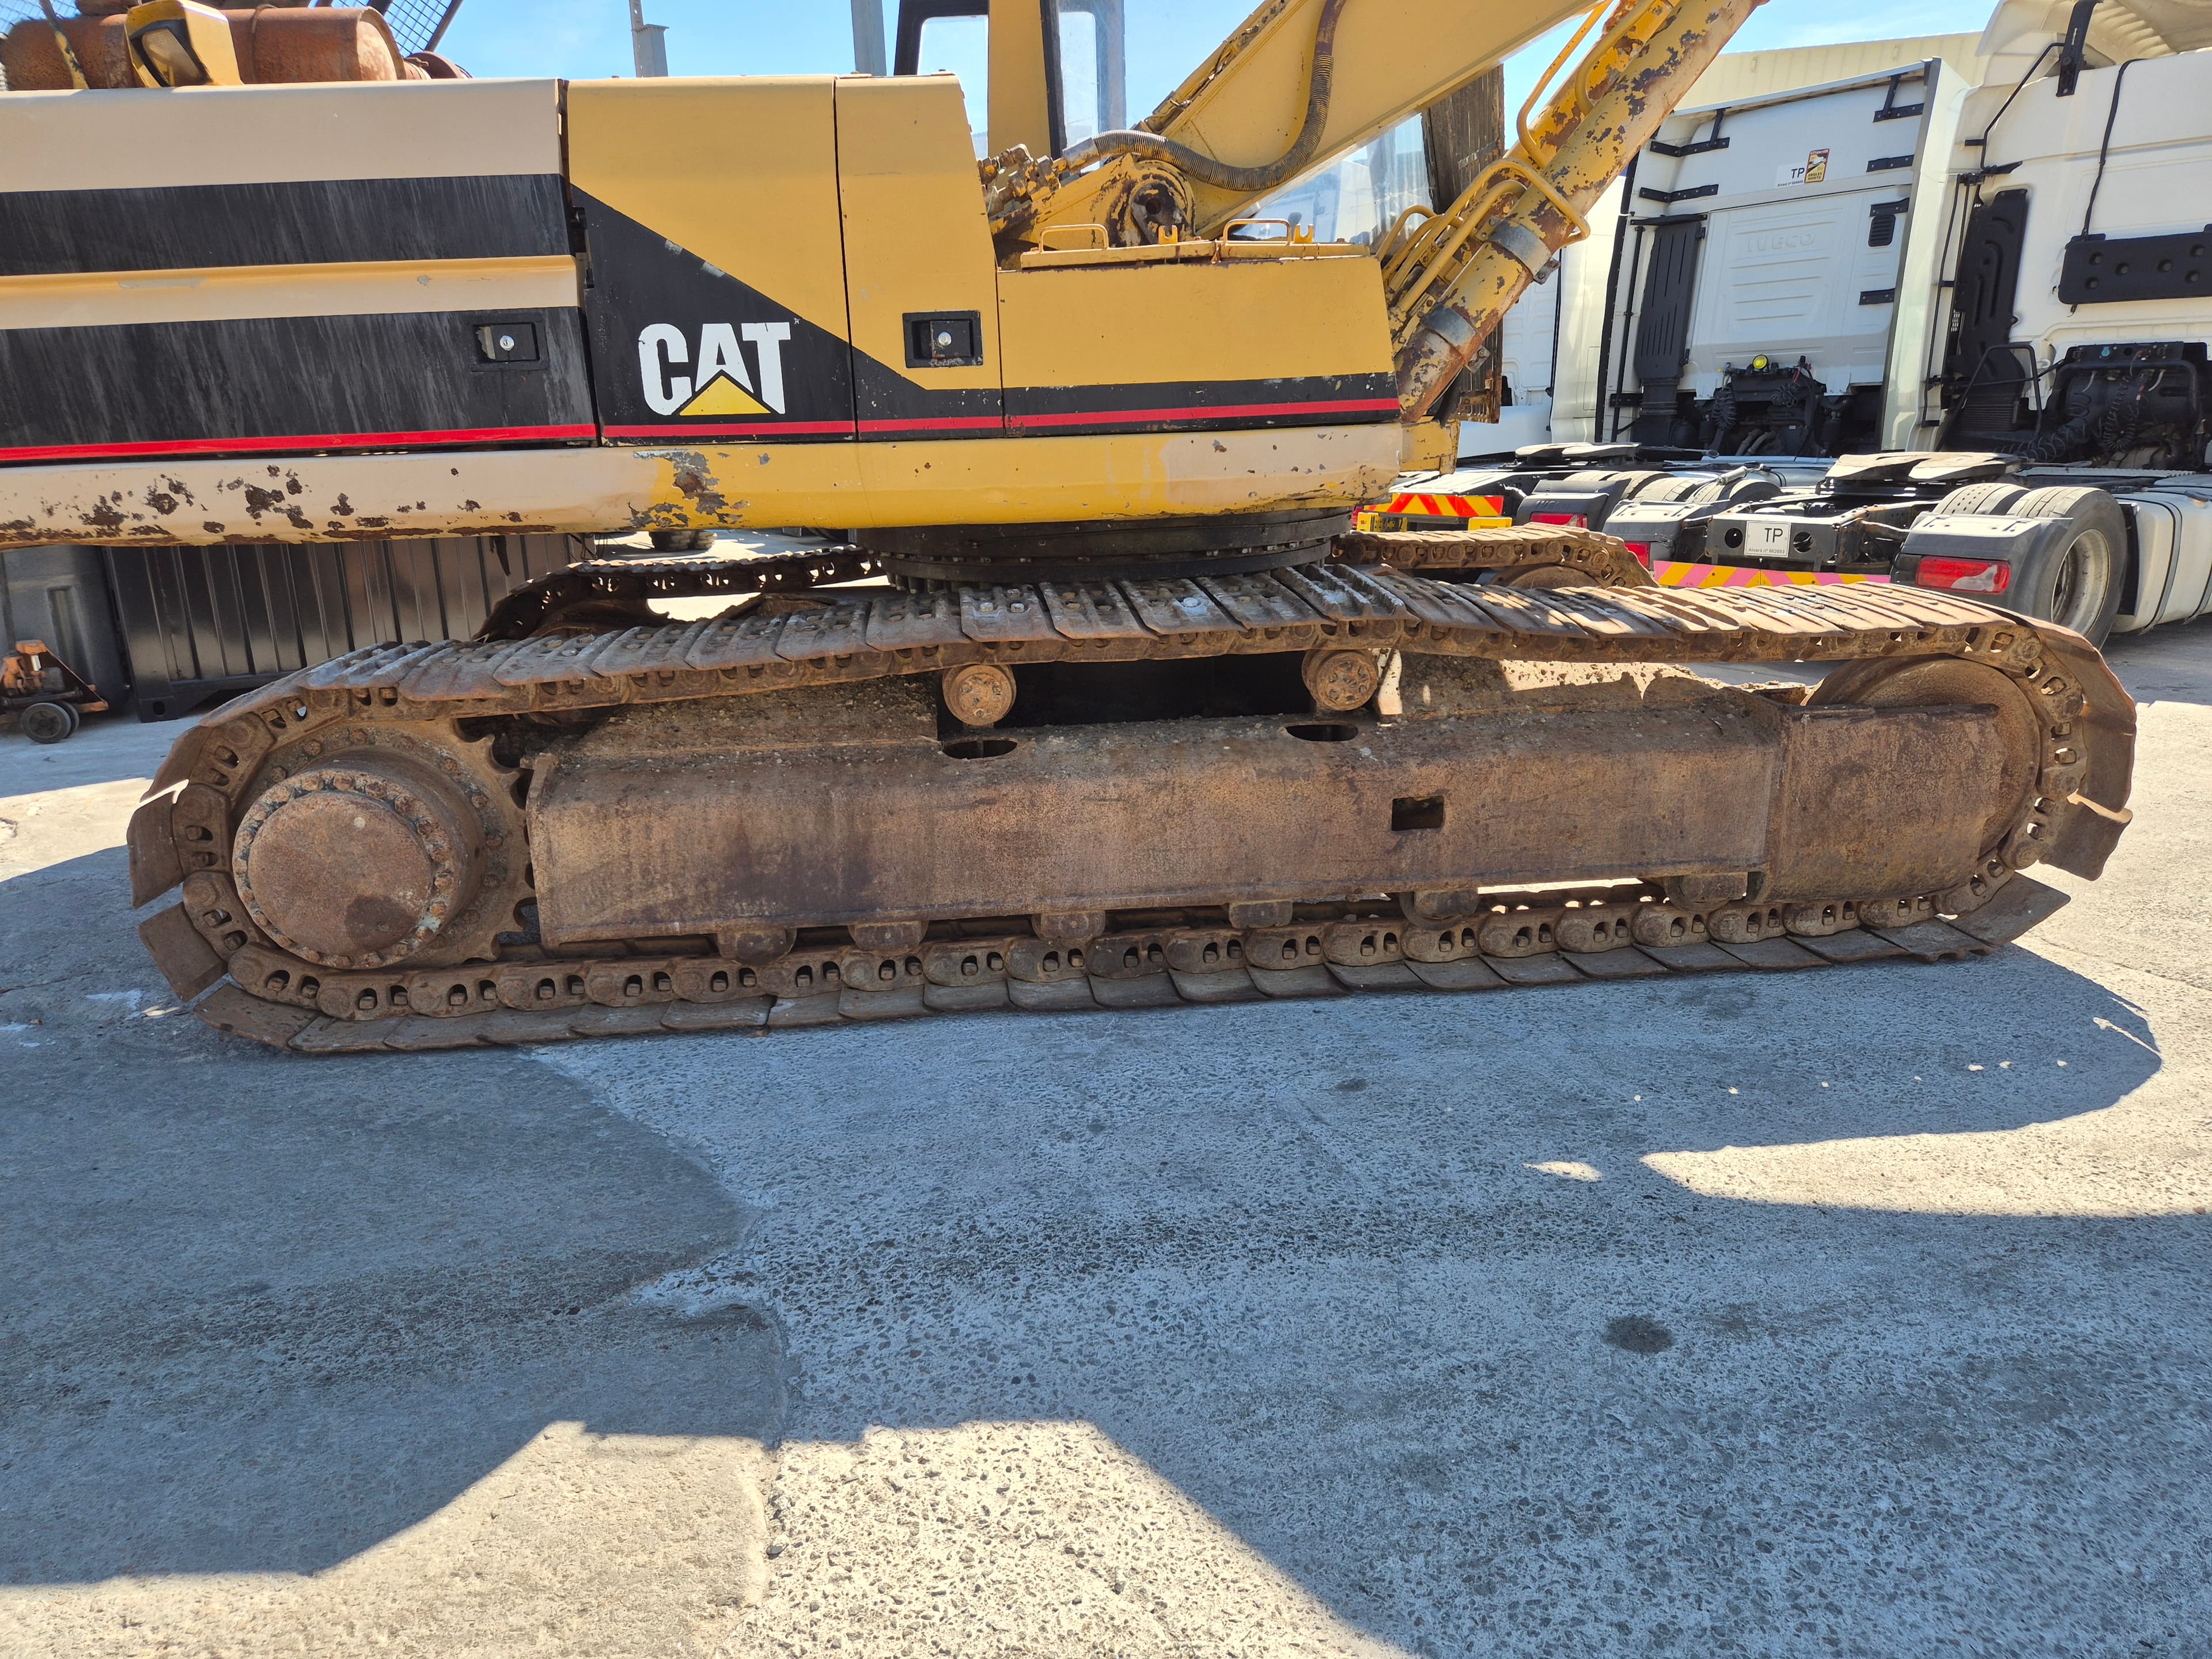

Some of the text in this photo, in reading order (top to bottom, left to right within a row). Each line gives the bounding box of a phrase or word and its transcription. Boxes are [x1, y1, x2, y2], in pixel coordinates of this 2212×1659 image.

[1791, 167, 1805, 179] TP
[1747, 230, 1816, 253] IVECO
[638, 322, 791, 415] CAT
[1764, 528, 1783, 543] TP
